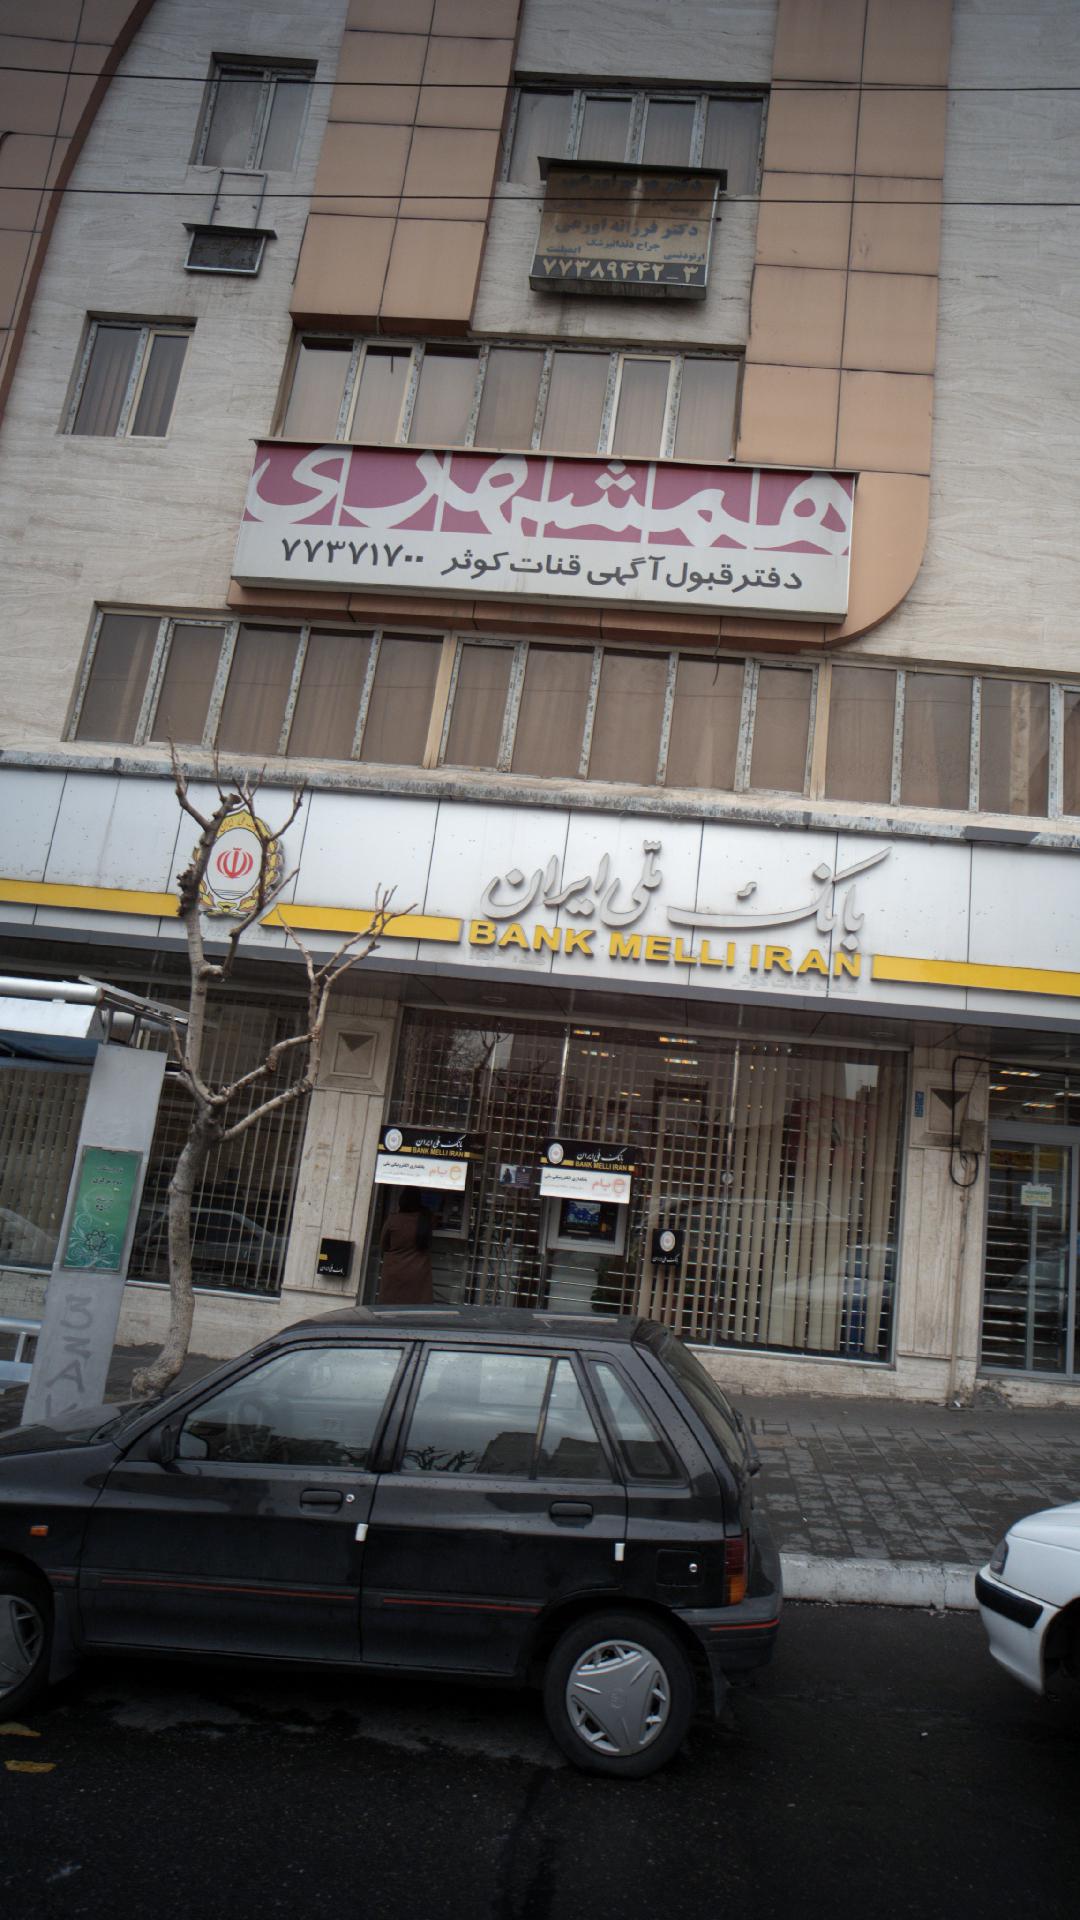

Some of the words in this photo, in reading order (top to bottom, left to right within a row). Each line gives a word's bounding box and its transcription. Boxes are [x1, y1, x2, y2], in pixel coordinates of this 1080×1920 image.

[636, 240, 661, 252] جراح
[661, 223, 699, 239] دکتر
[244, 444, 853, 556] همشهری
[440, 549, 509, 580] کوثر
[509, 553, 581, 576] قنات
[586, 556, 666, 587] آگهی
[666, 562, 733, 592] قبول
[732, 567, 803, 593] دفتر
[480, 851, 611, 920] ایران
[599, 839, 663, 928] ملی
[667, 846, 893, 952] بانک
[468, 918, 596, 957] BANK
[608, 931, 737, 969] MELLI
[750, 944, 863, 979] IRAN
[412, 1146, 430, 1154] BANK
[430, 1148, 449, 1156] MELLI
[449, 1150, 464, 1158] IRAN
[593, 1162, 612, 1170] MELLI
